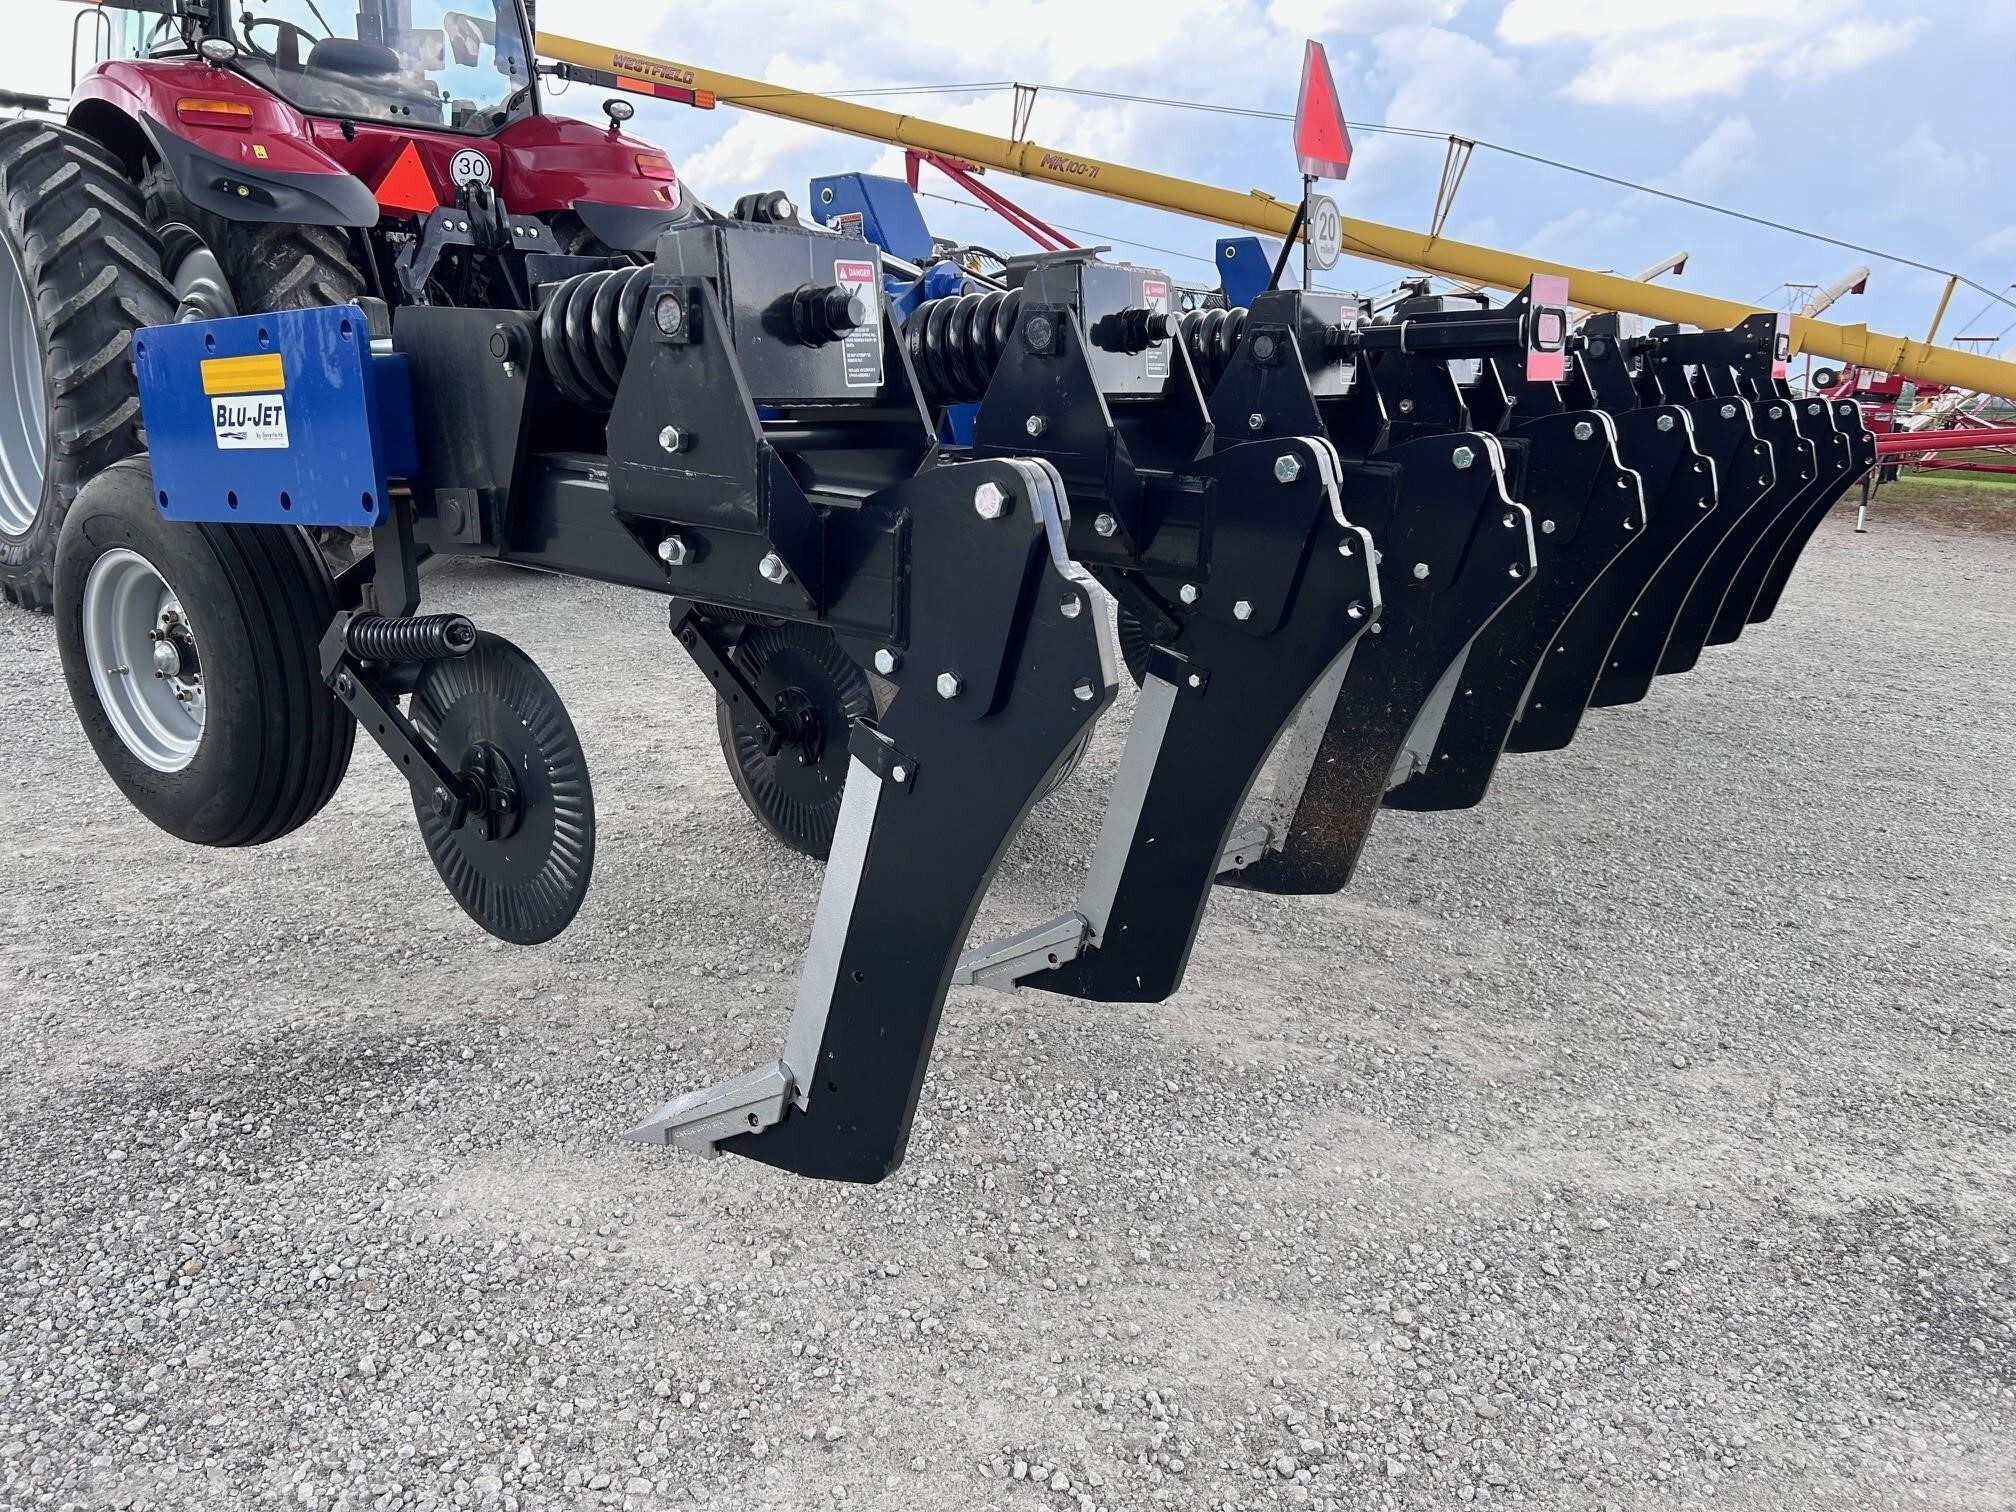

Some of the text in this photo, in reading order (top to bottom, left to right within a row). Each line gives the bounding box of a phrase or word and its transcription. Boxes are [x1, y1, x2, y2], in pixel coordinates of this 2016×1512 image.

[613, 54, 695, 84] WESTFIELD
[459, 157, 484, 177] 30
[1319, 212, 1336, 241] 20
[848, 268, 871, 277] DANGER
[216, 403, 282, 427] BLU-JET
